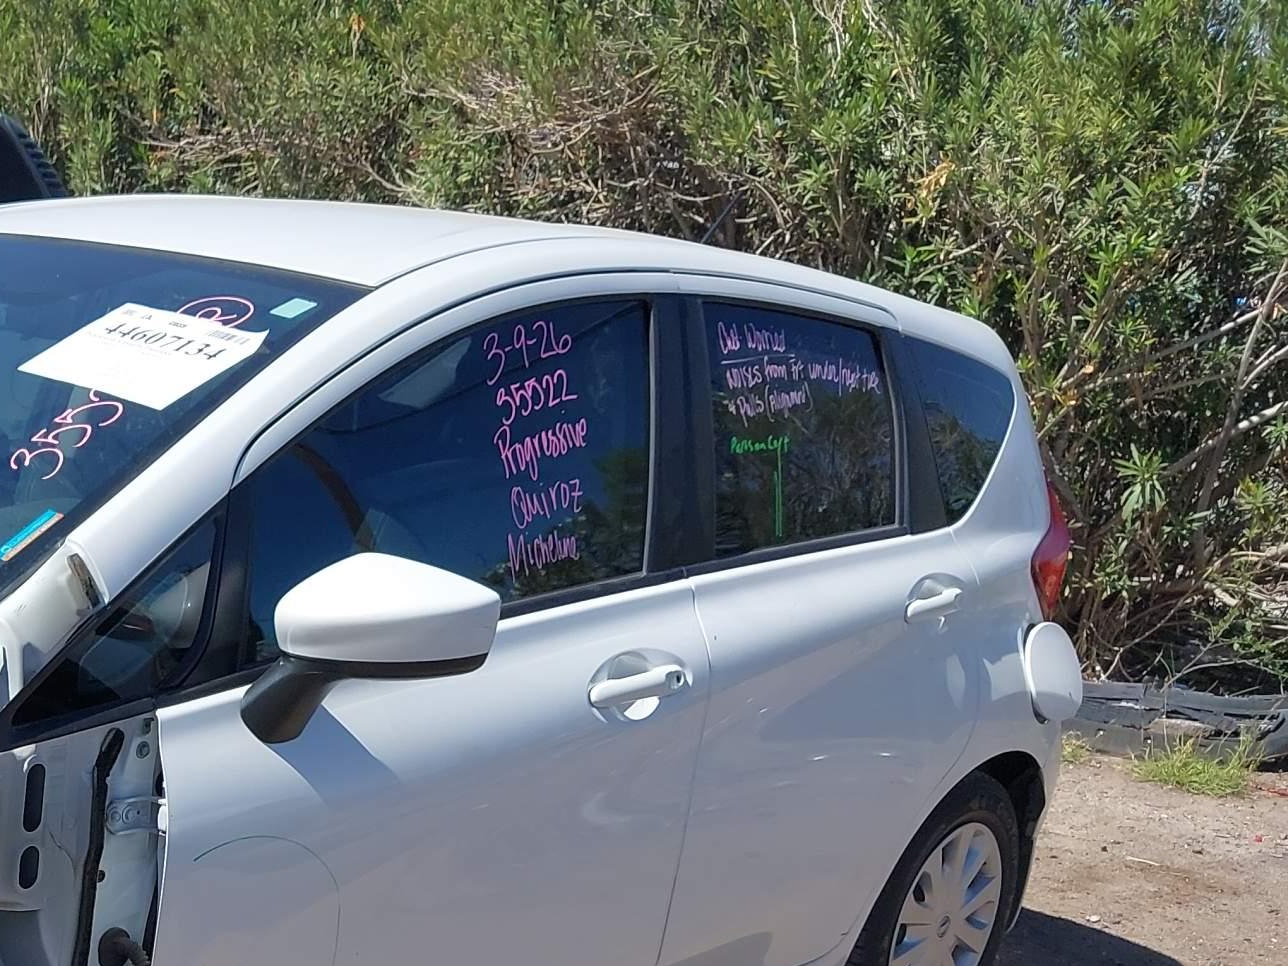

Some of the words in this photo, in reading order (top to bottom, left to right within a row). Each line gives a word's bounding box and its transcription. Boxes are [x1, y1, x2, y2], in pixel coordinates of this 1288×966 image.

[104, 312, 228, 361] 44607134
[483, 320, 572, 386] 3-9-26
[496, 368, 578, 425] 35522
[493, 418, 587, 482] Progressive
[511, 478, 583, 529] Quiroz
